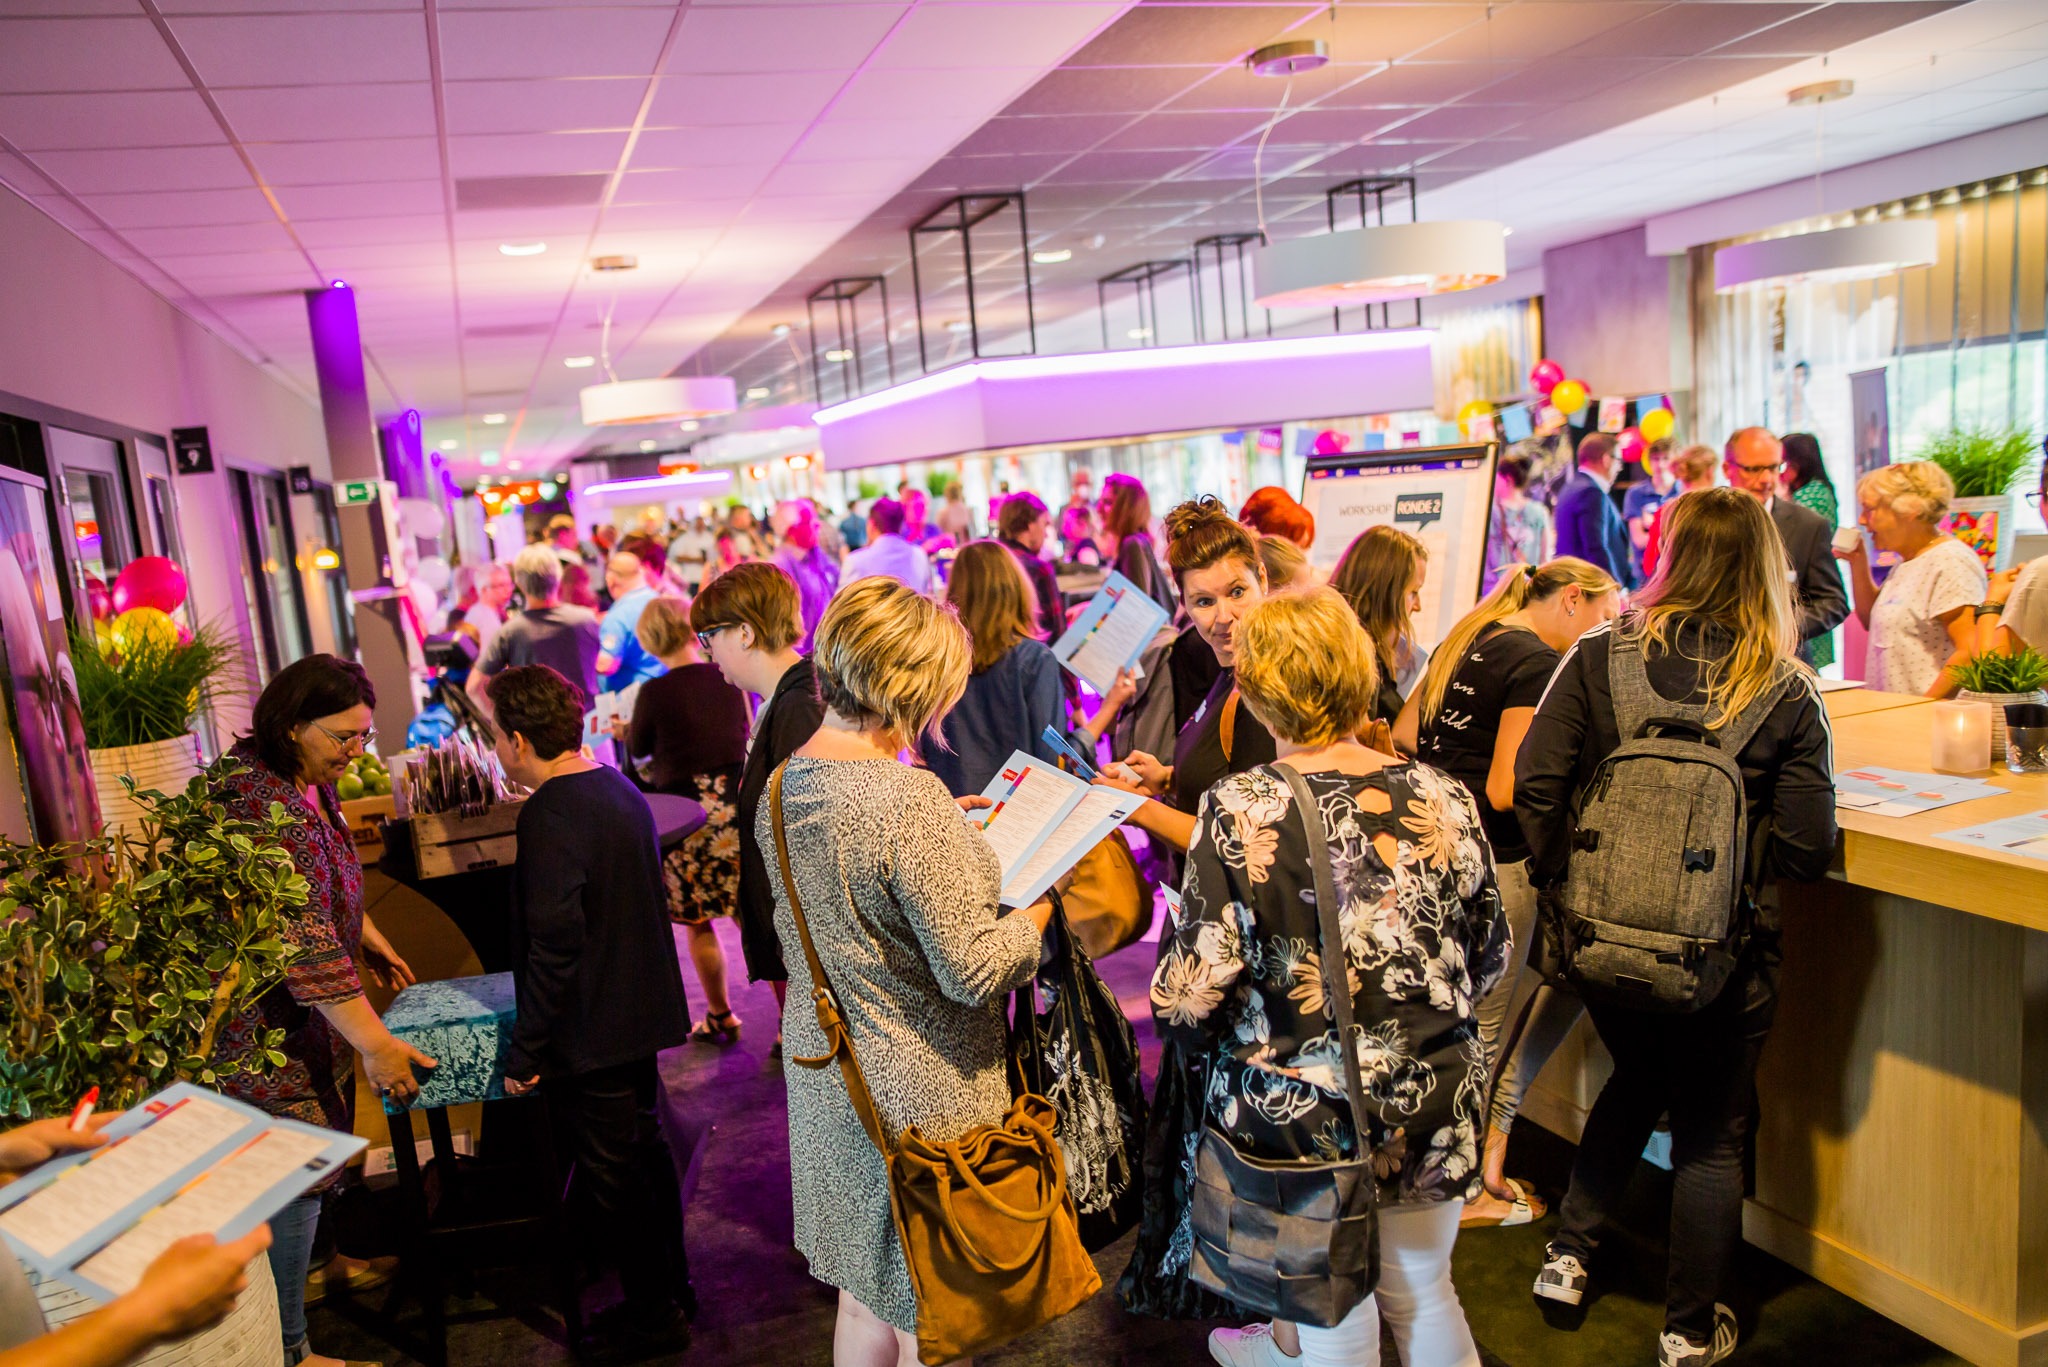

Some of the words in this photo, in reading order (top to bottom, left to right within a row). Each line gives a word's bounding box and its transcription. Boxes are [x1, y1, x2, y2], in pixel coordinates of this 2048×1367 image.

[187, 449, 199, 466] 9
[1338, 503, 1392, 517] WORKSHOP
[1396, 500, 1432, 515] RONDE
[1432, 499, 1441, 513] 2
